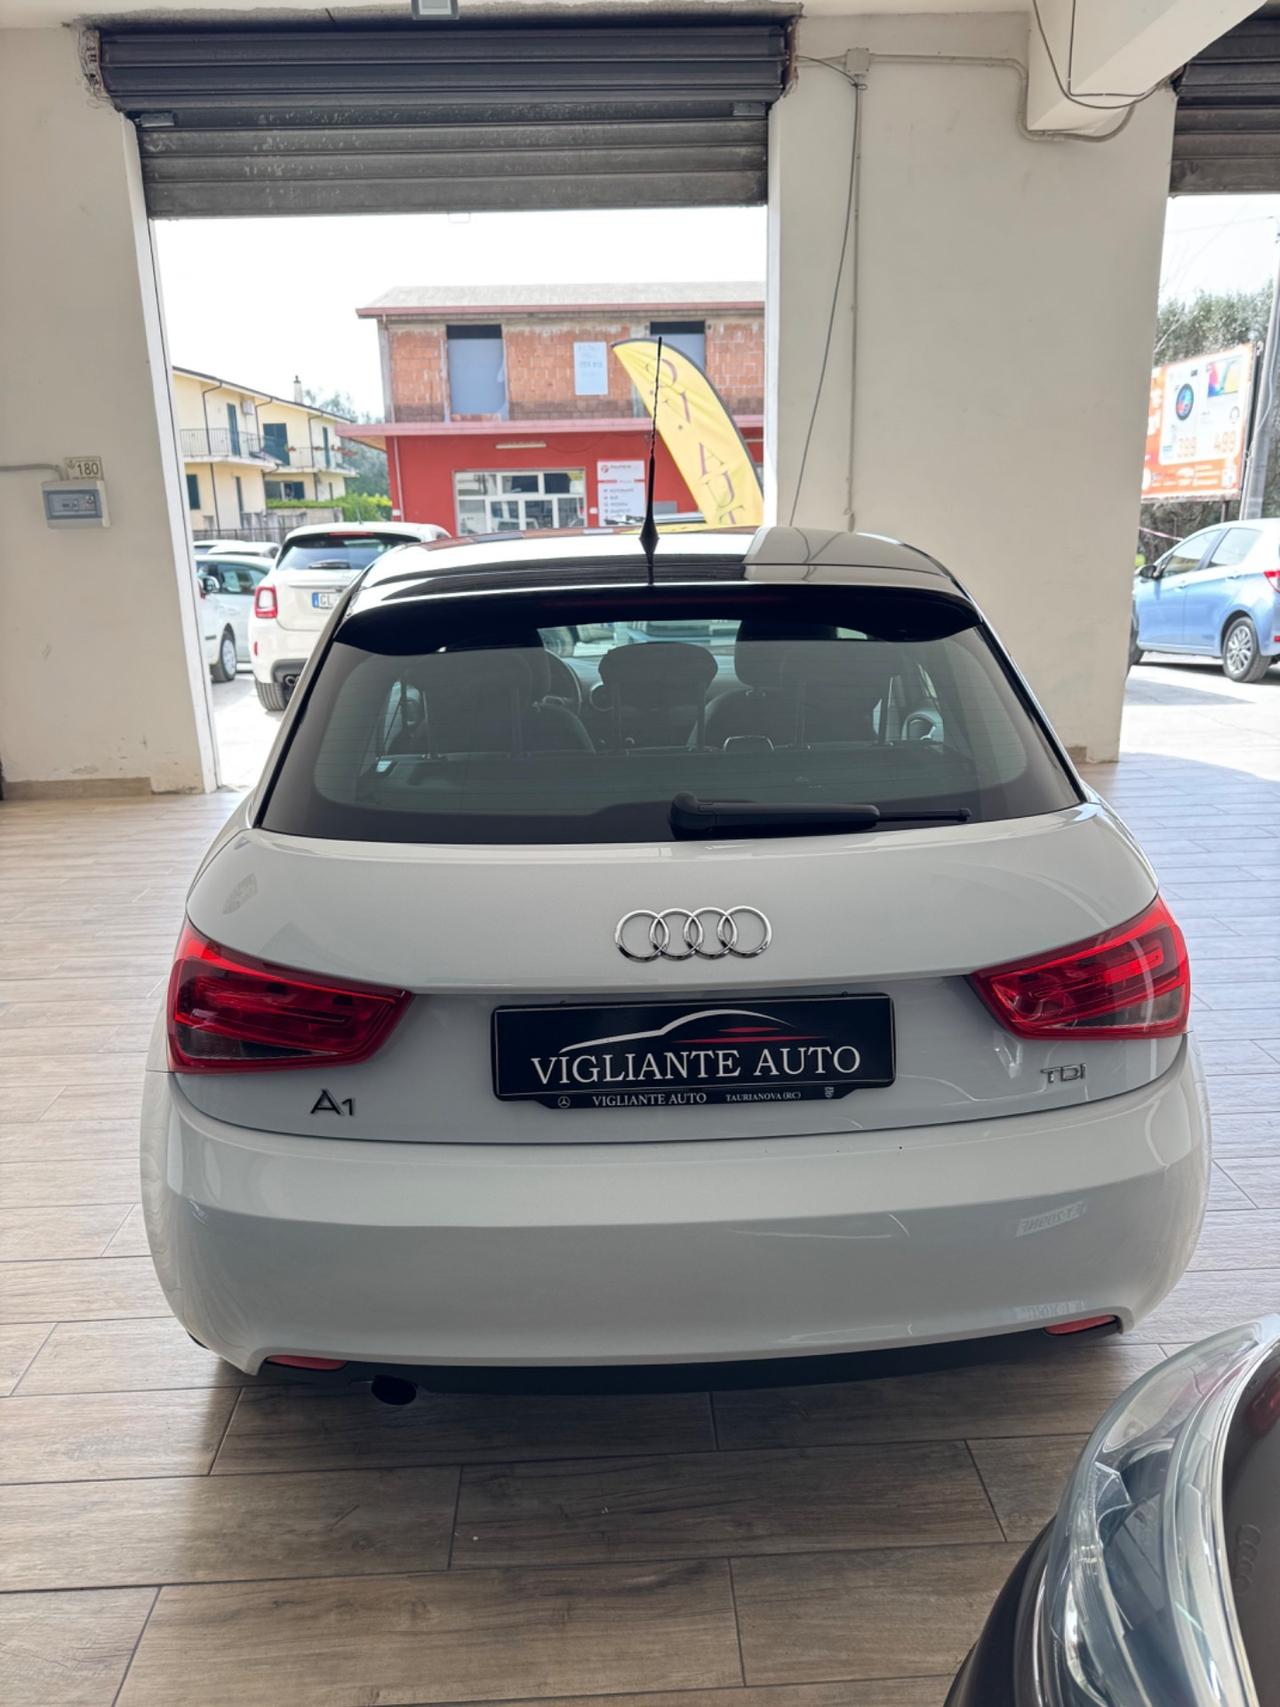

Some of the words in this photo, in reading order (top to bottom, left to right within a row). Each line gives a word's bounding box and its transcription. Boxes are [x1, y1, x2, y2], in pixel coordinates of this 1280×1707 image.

[77, 463, 99, 475] 180
[531, 1049, 742, 1085] VIGLIANTE
[752, 1046, 861, 1075] AUTO
[1040, 1063, 1087, 1083] TDI
[310, 1089, 354, 1116] A1
[592, 1094, 666, 1107] VIGLIANTE
[668, 1093, 708, 1105] AUTO
[725, 1093, 783, 1103] TAURIANOVA
